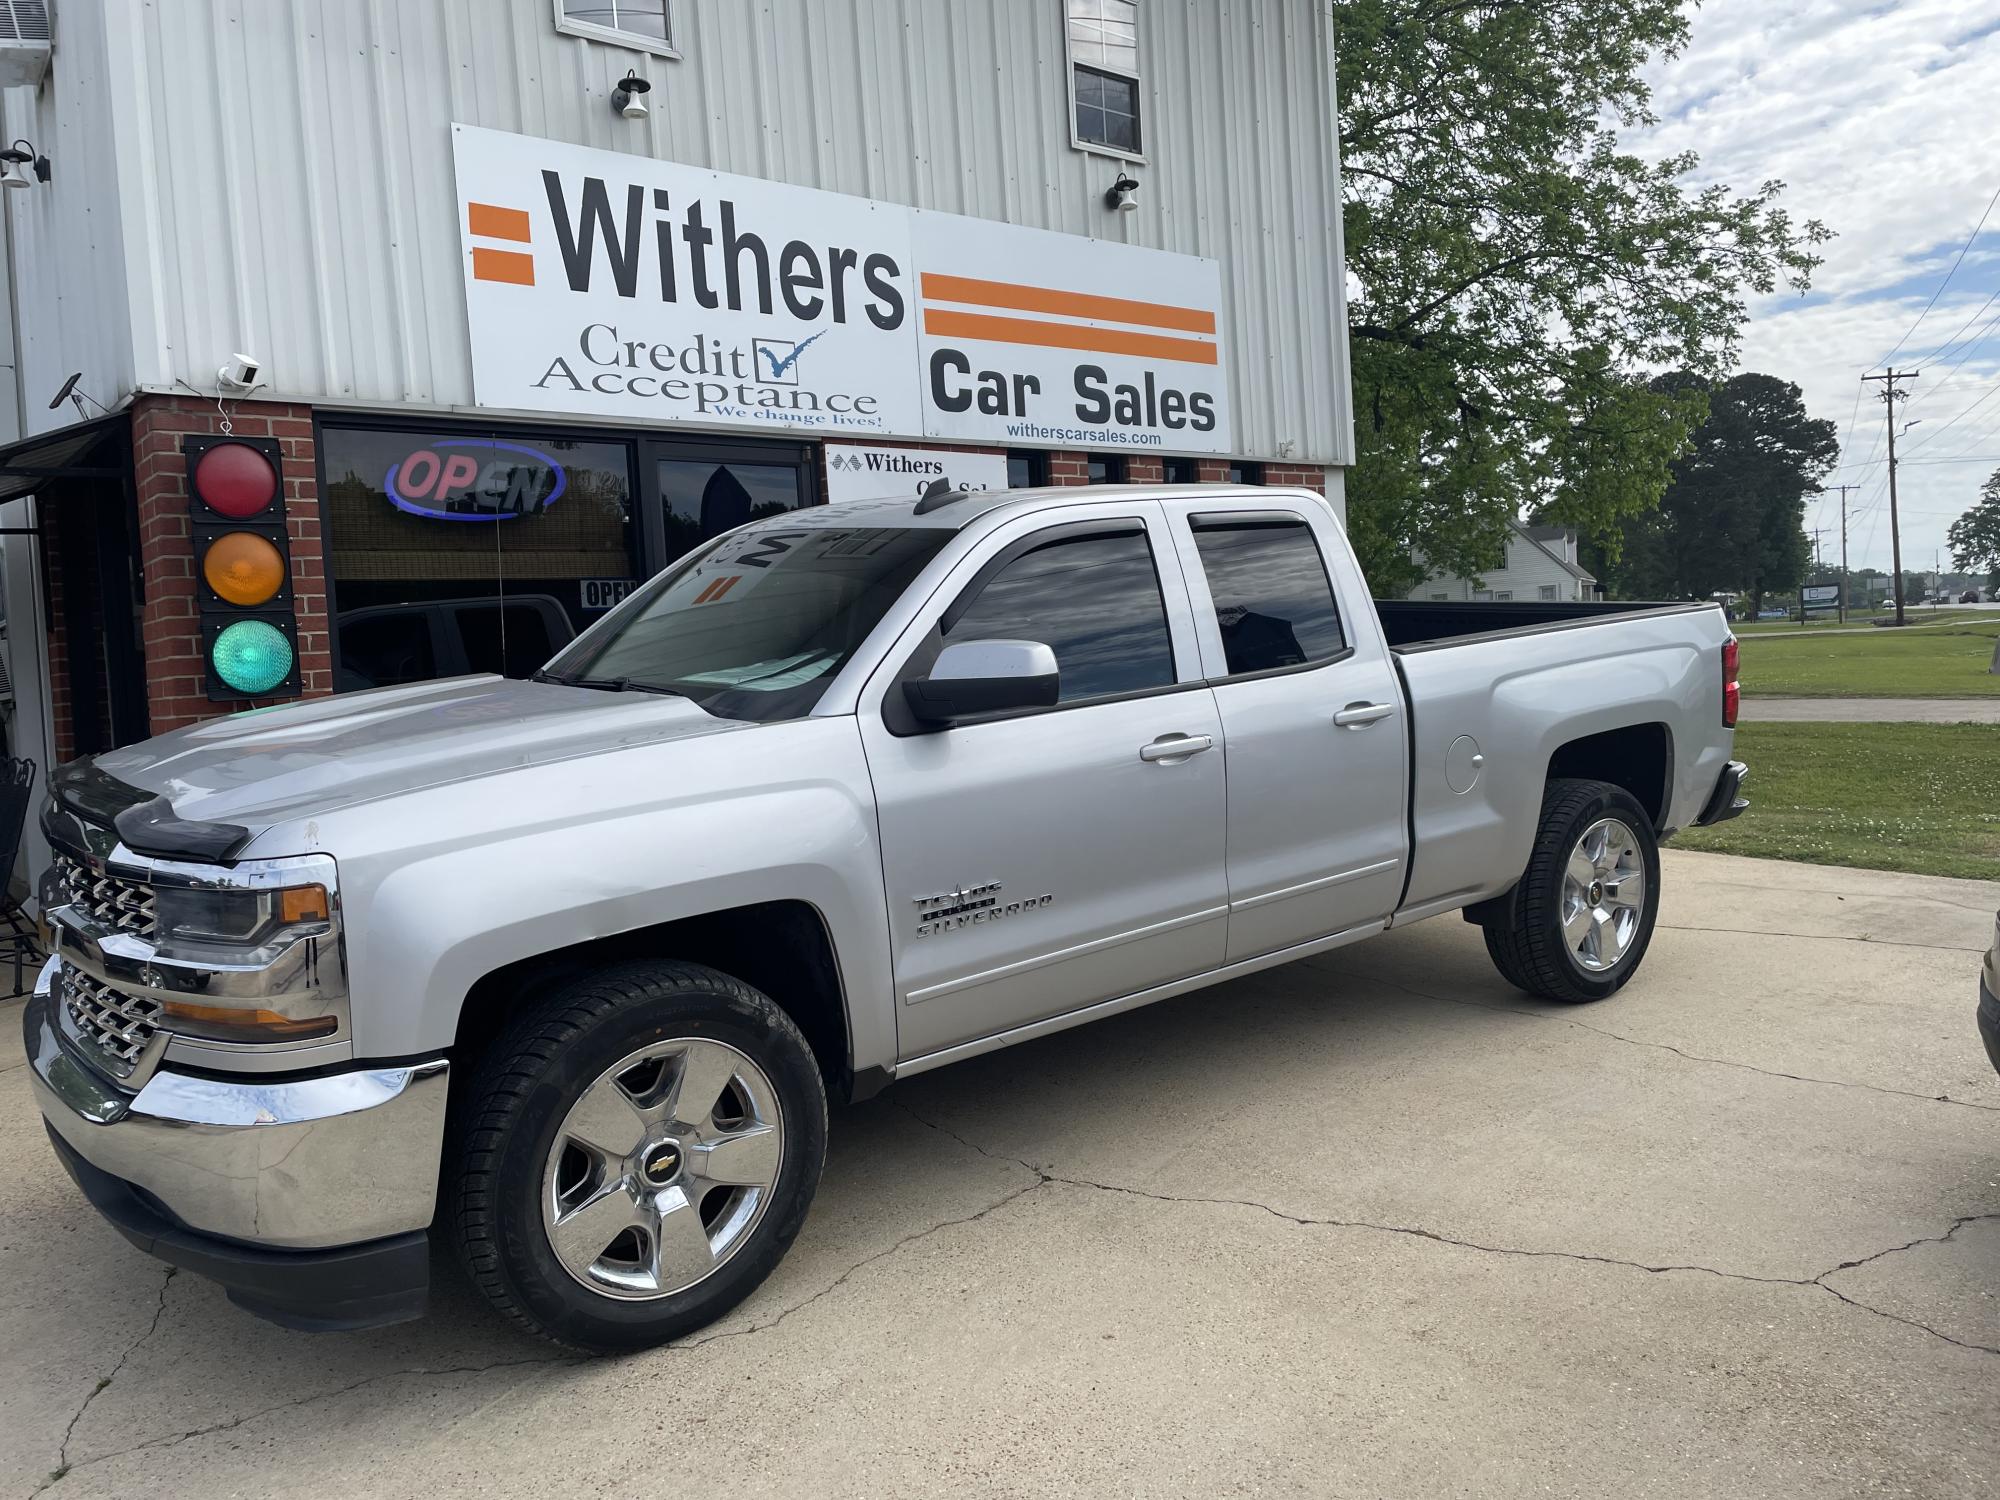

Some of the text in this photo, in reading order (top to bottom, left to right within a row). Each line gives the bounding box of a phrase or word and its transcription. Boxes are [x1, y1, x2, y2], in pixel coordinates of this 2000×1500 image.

[541, 169, 905, 331] Withers
[579, 323, 748, 379] Credit
[530, 356, 878, 415] Acceptance
[929, 348, 1216, 432] Car Sales
[713, 404, 882, 428] We change lives!
[1006, 423, 1162, 446] witherscarsales.com
[397, 449, 549, 513] OPEN
[864, 452, 943, 475] Withers
[916, 893, 1053, 939] SILVERADO
